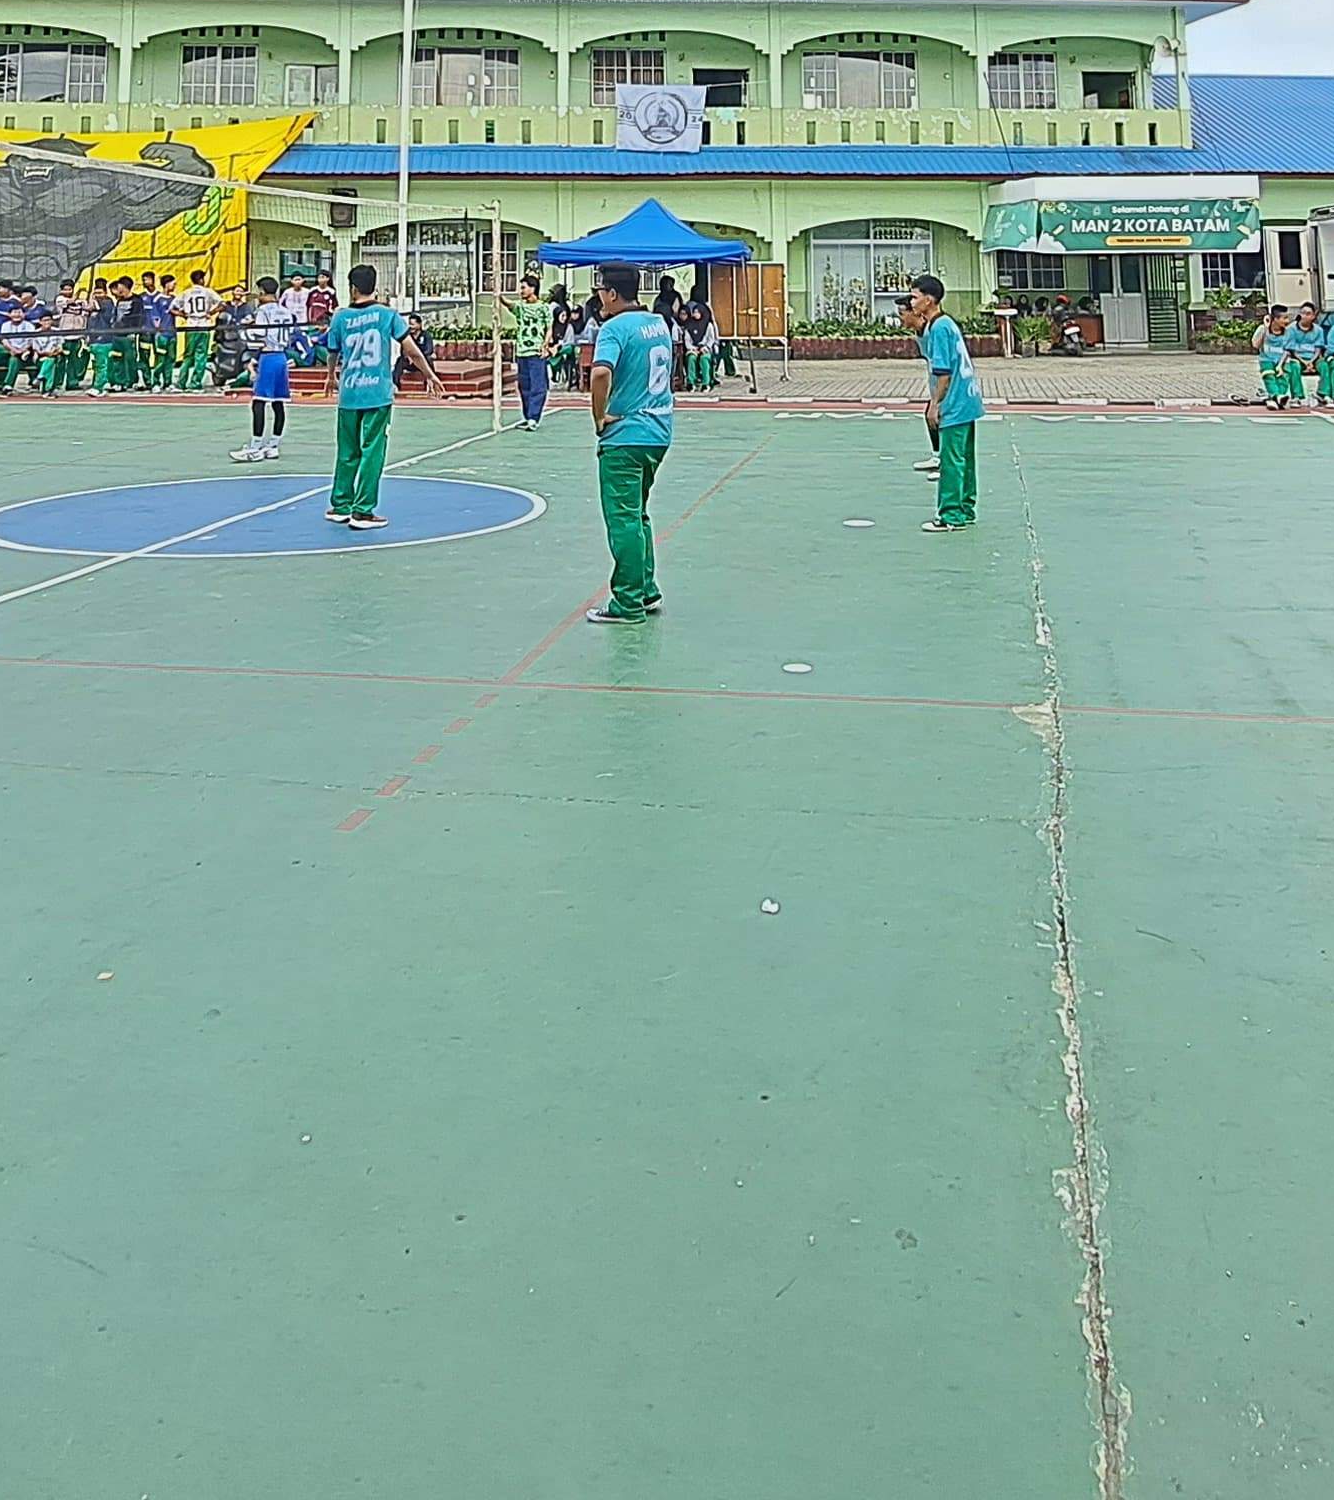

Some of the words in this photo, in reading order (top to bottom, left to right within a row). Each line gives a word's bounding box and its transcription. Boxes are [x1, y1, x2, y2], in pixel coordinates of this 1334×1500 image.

[1111, 205, 1147, 214] Selamat
[1148, 205, 1179, 216] Datang
[1071, 218, 1110, 234] MAN
[1113, 219, 1122, 233] 2
[1125, 218, 1168, 233] KOTA
[1172, 217, 1230, 233] BATAM
[187, 295, 206, 315] 10
[346, 328, 382, 370] 29
